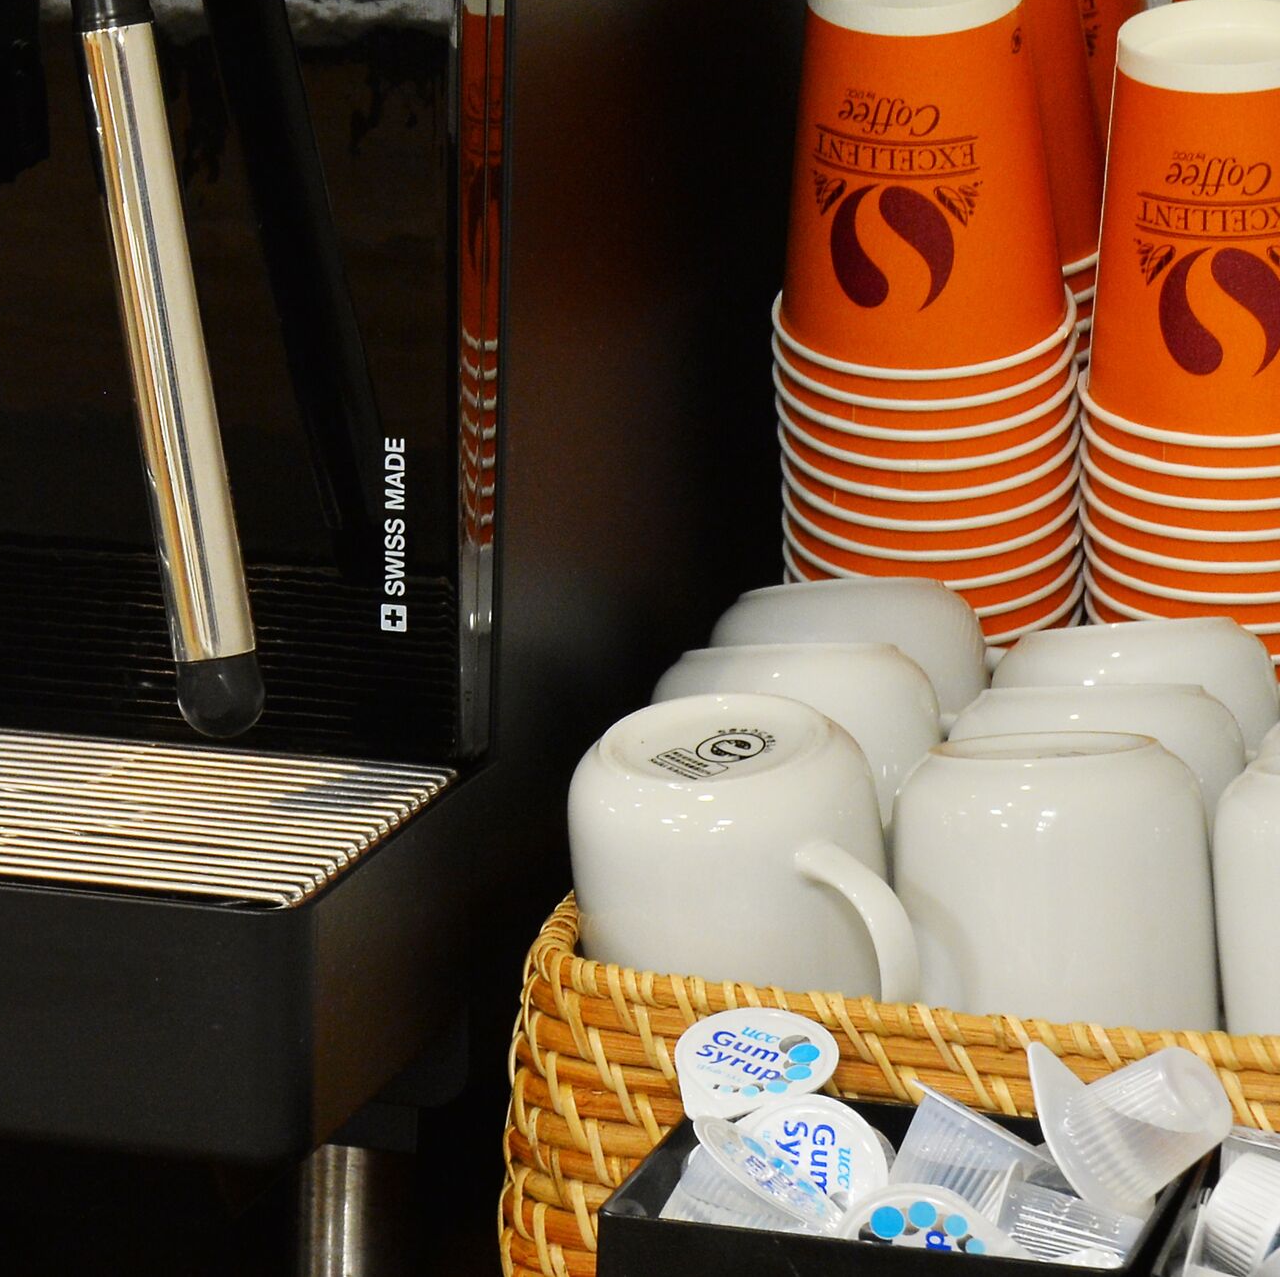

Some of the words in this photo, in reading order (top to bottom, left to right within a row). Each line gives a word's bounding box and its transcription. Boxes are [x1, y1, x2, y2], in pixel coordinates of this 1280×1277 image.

[839, 98, 940, 136] Coffee
[814, 133, 975, 171] EXCELLENT
[1165, 157, 1272, 196] Coffee
[1137, 201, 1280, 232] XCELLENT
[385, 438, 405, 510] MADE
[385, 519, 405, 596] SWISS
[696, 1044, 781, 1081] Syrup
[712, 1030, 780, 1063] Gum
